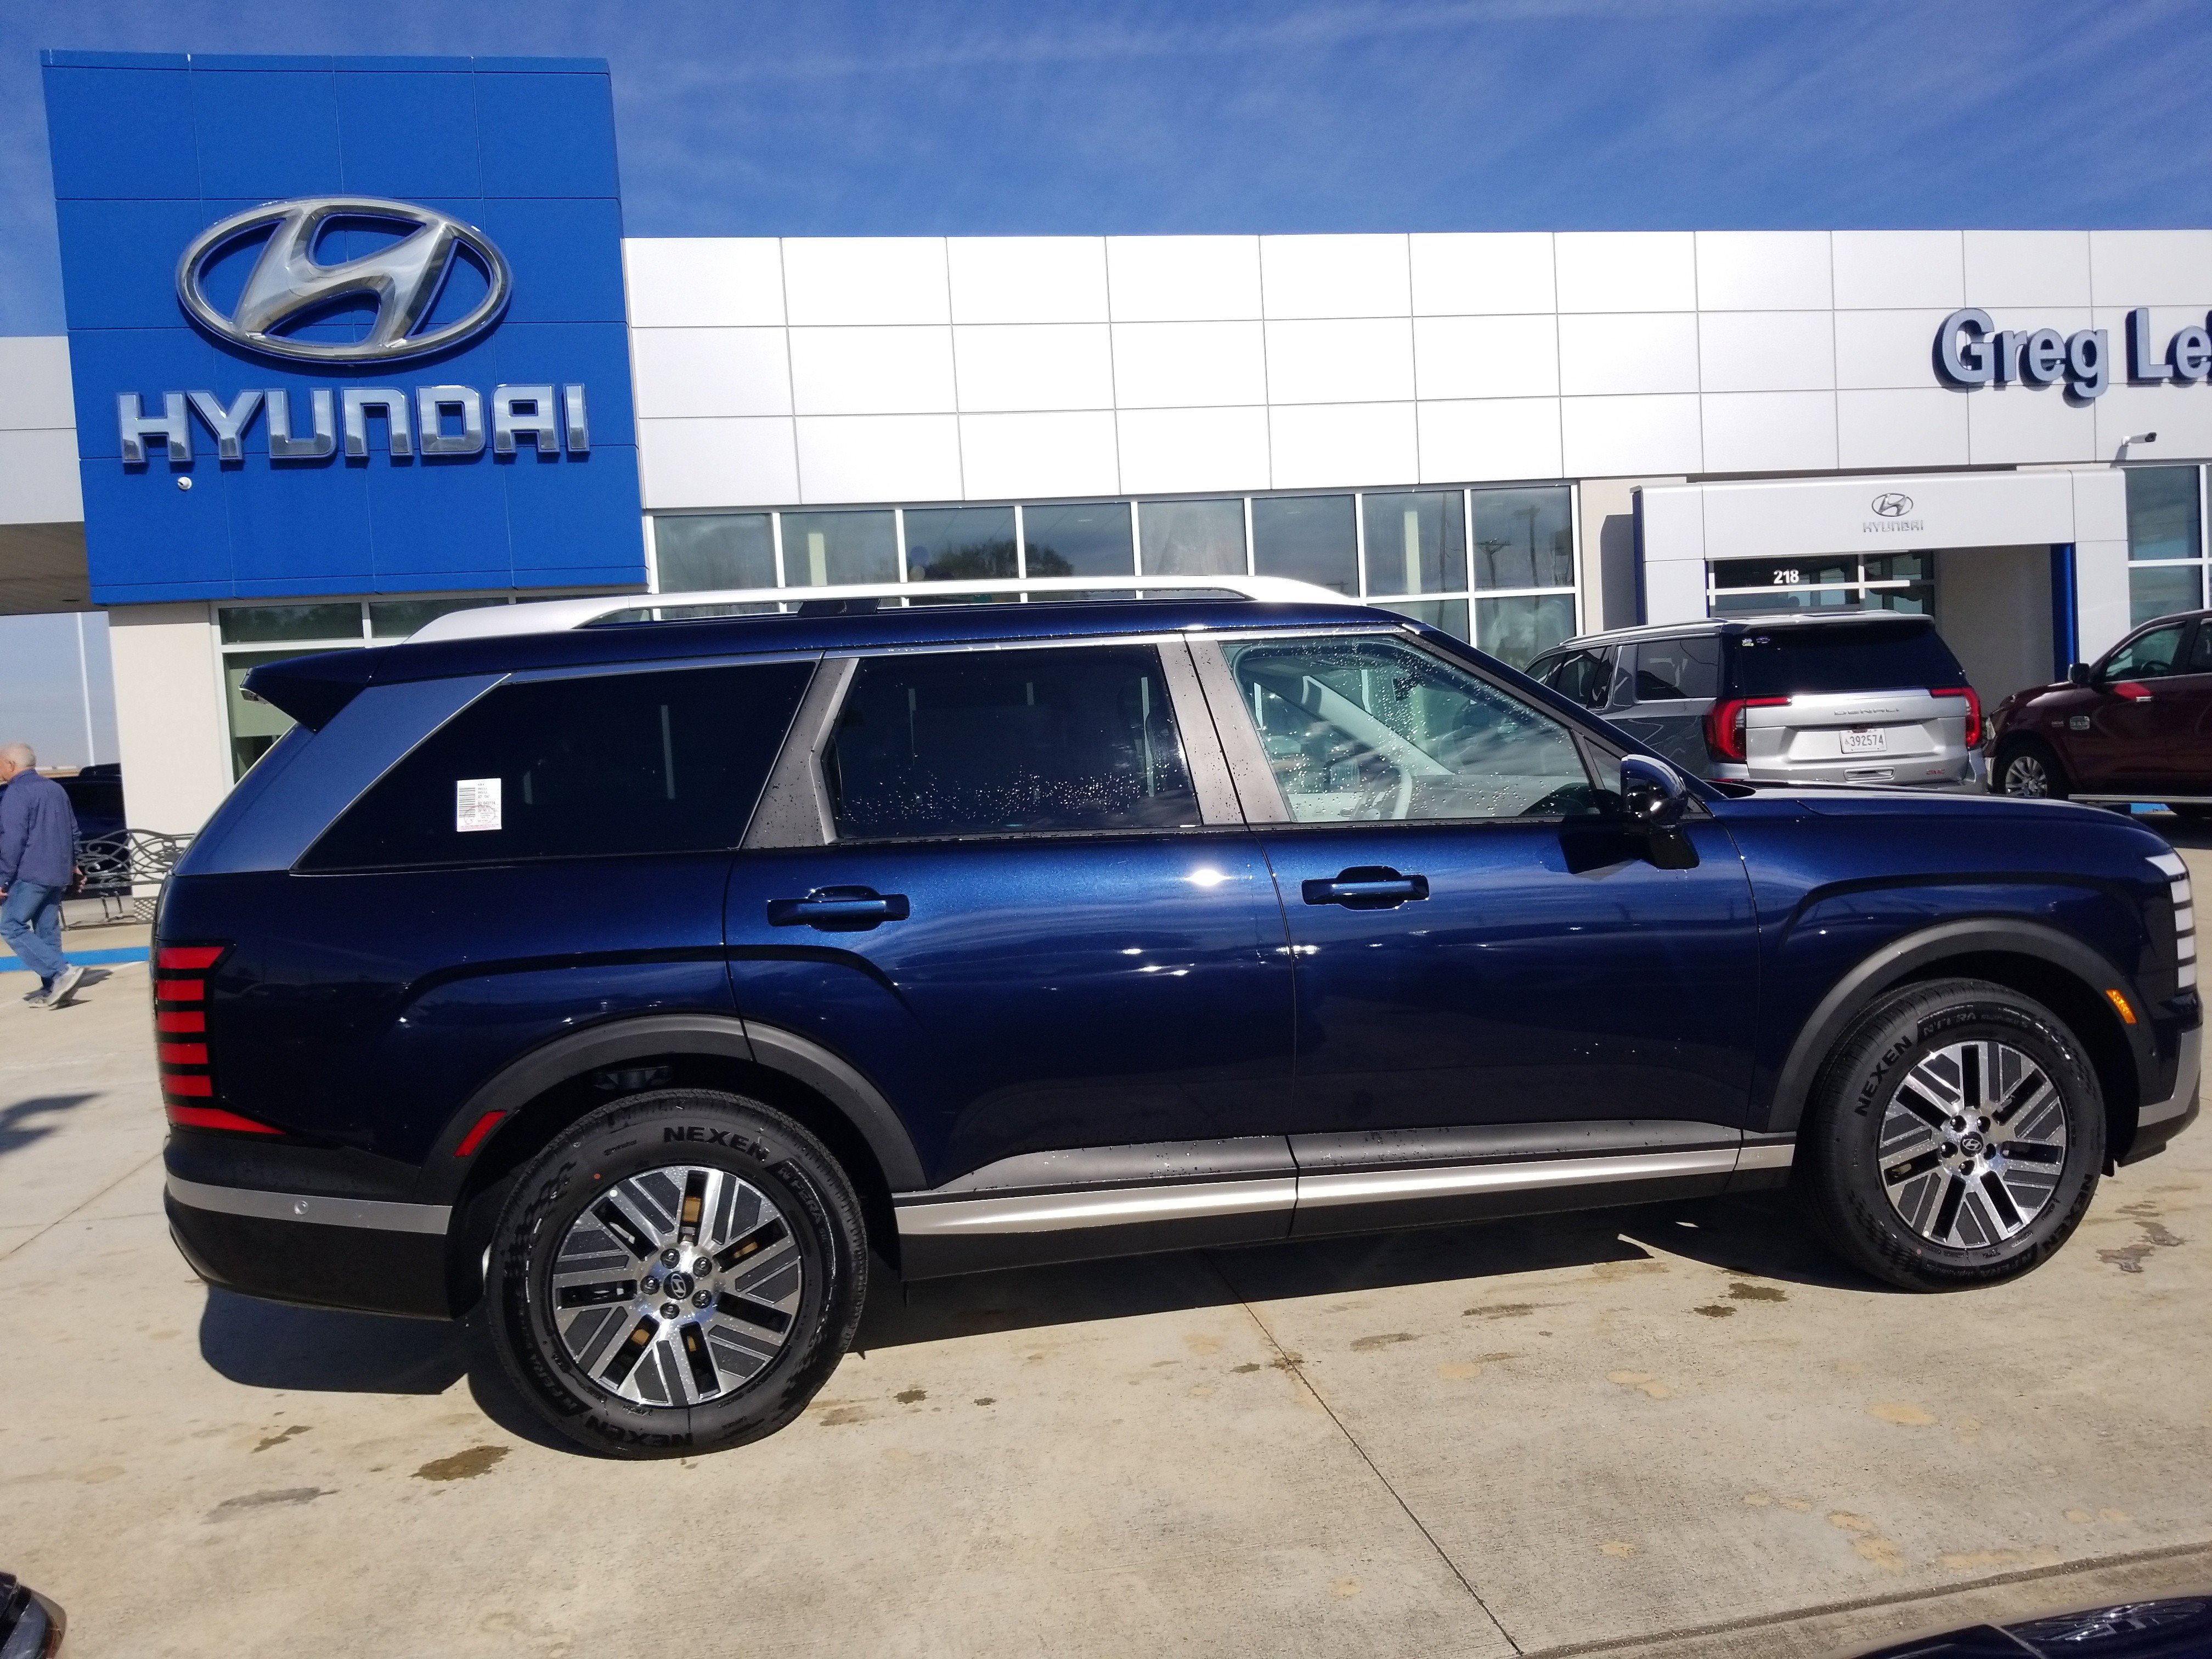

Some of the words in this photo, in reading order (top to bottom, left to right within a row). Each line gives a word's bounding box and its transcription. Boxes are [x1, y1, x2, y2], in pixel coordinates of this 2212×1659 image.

[1934, 308, 2108, 402] Greg
[2126, 308, 2212, 382] Le
[117, 384, 590, 464] HYUNDAI
[1863, 520, 1923, 532] HYUNDAI
[1774, 569, 1799, 584] 218
[1849, 735, 1884, 747] 392574
[1854, 1035, 1912, 1117] NEXEN
[664, 1126, 769, 1162] NEXEN
